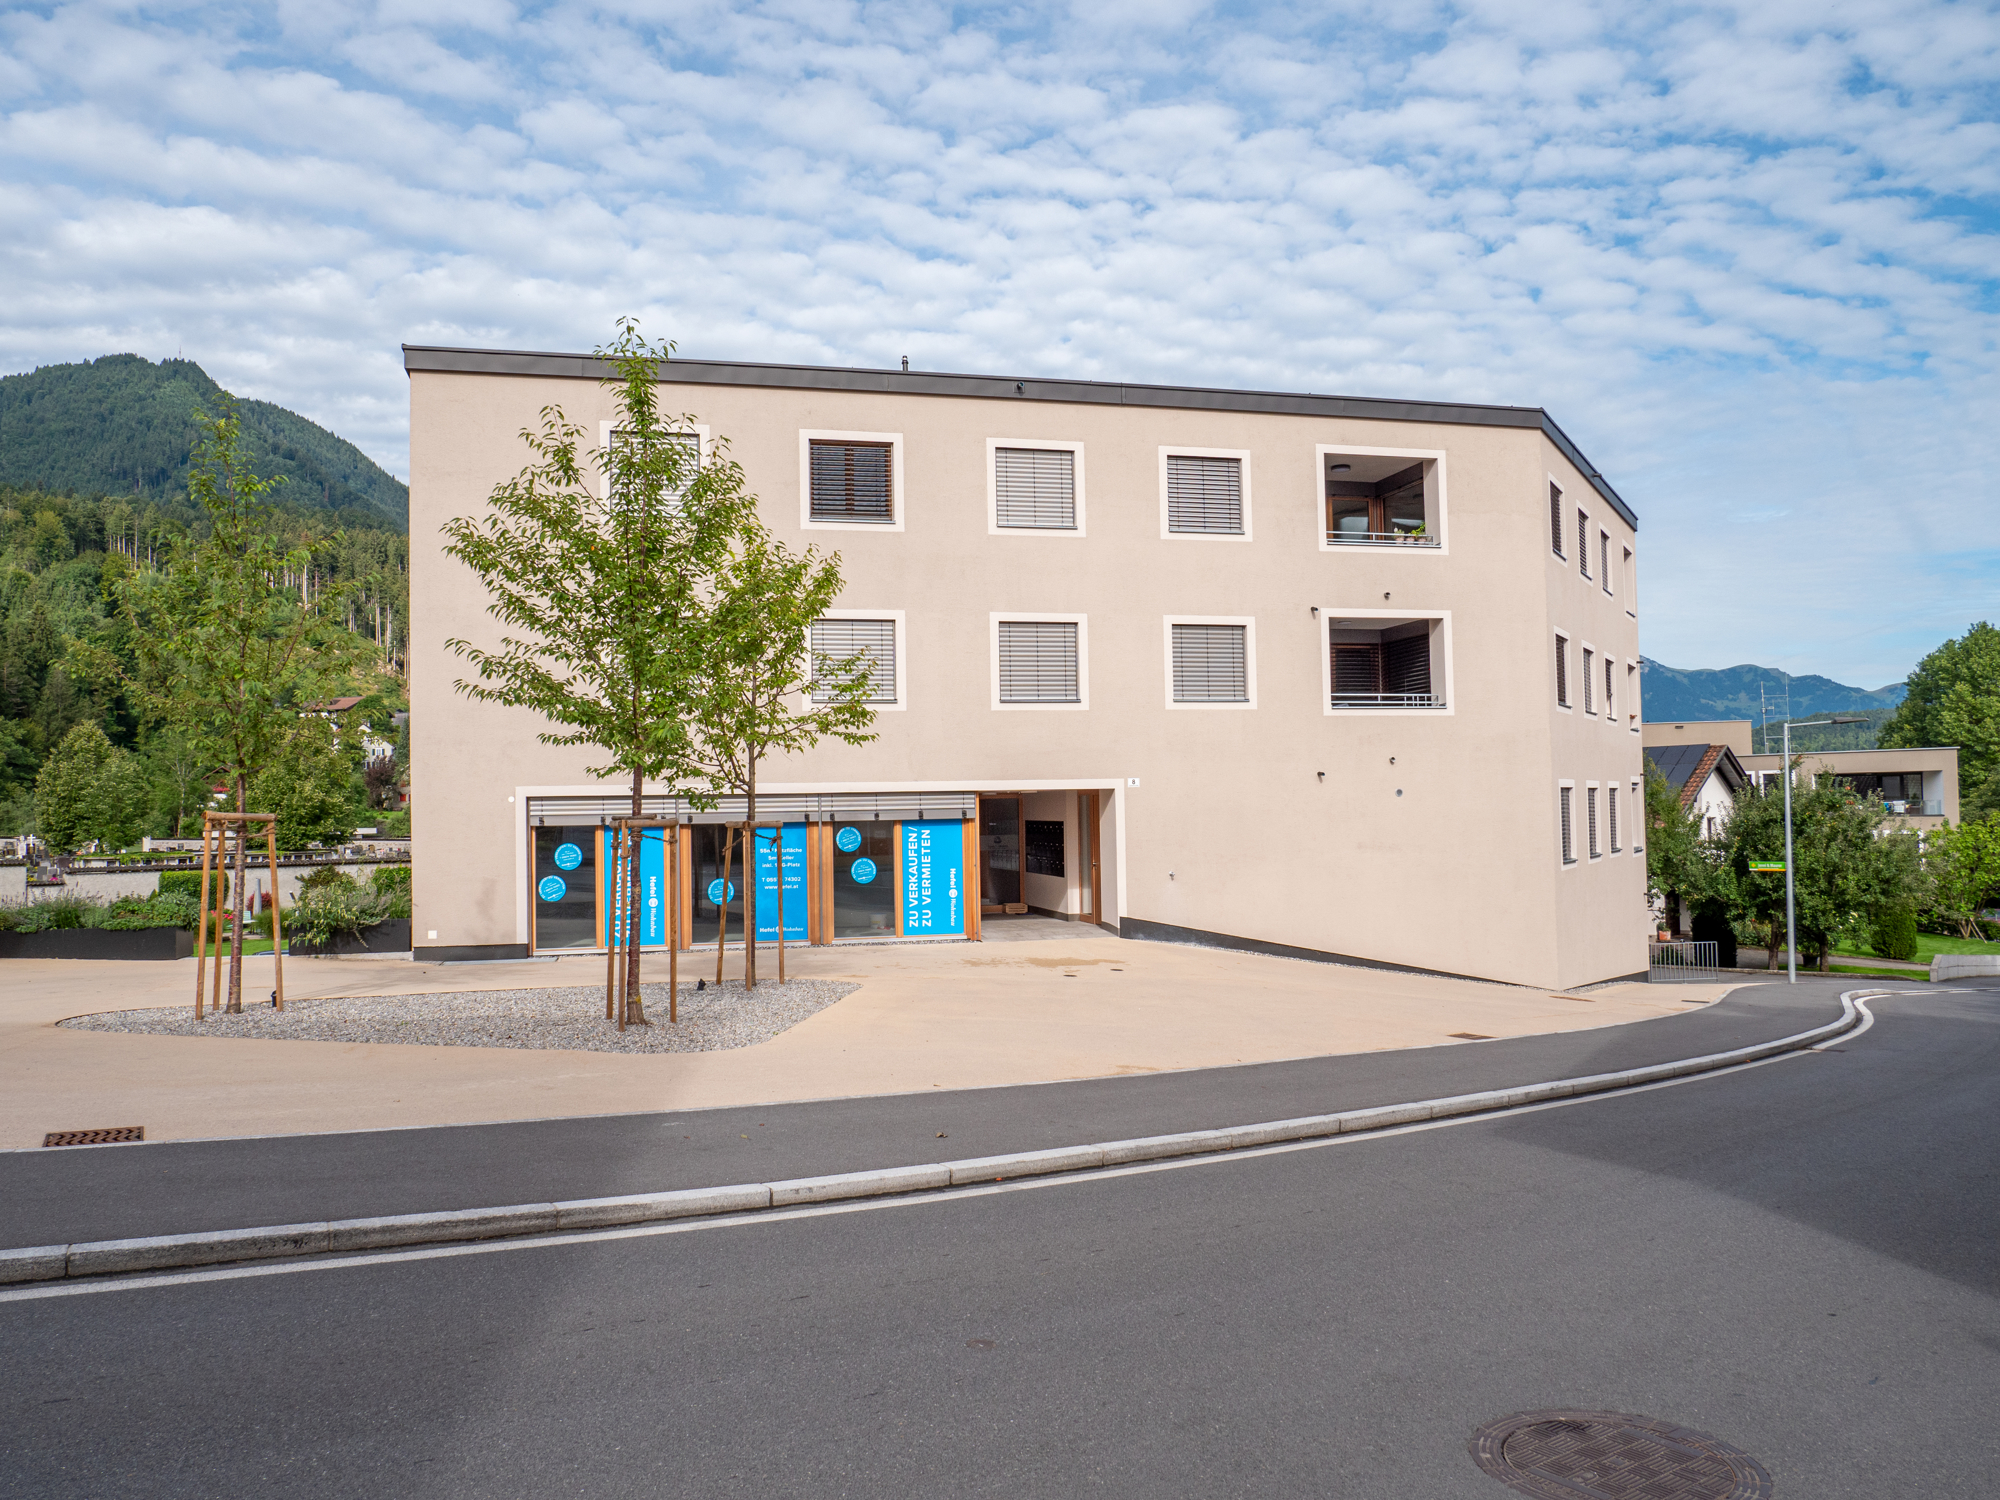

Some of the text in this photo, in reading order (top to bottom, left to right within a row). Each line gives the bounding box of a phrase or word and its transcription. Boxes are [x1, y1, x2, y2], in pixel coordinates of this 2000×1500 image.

[922, 830, 931, 927] ZU VERMIETEN
[909, 910, 918, 927] ZU
